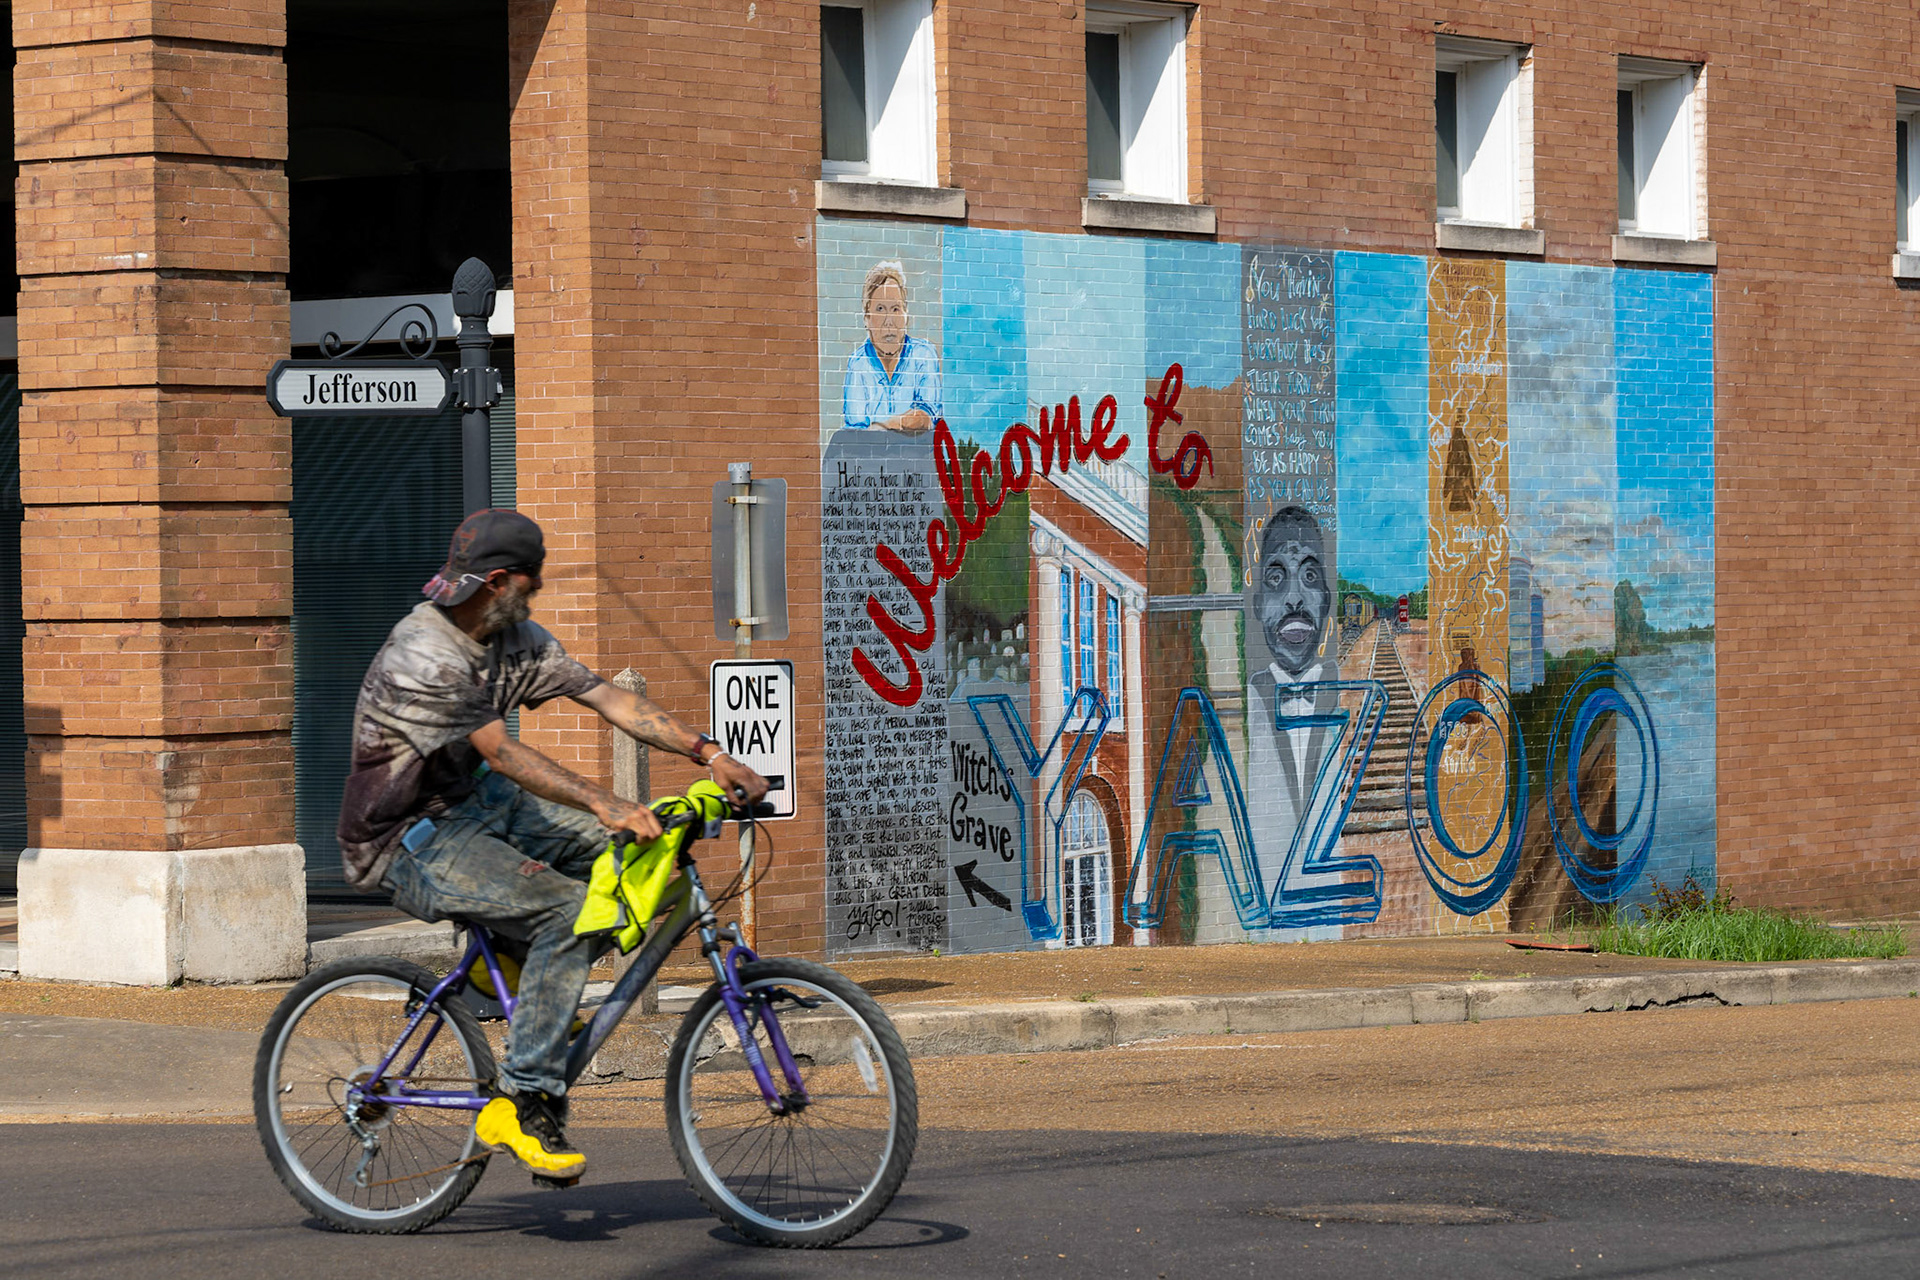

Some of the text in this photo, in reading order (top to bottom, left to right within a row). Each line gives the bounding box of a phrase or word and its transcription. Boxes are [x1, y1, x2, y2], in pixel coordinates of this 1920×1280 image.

[303, 373, 417, 404] Jefferson
[1244, 398, 1276, 422] WHEN
[1244, 423, 1280, 447] COMES
[1253, 450, 1271, 474] BE
[851, 363, 1214, 708] Welcome to
[726, 675, 779, 711] ONE
[725, 719, 781, 755] WAY
[951, 740, 1014, 802] Witch's
[967, 663, 1660, 941] YAZOO
[950, 792, 1014, 862] Grave
[889, 885, 919, 900] GREAT
